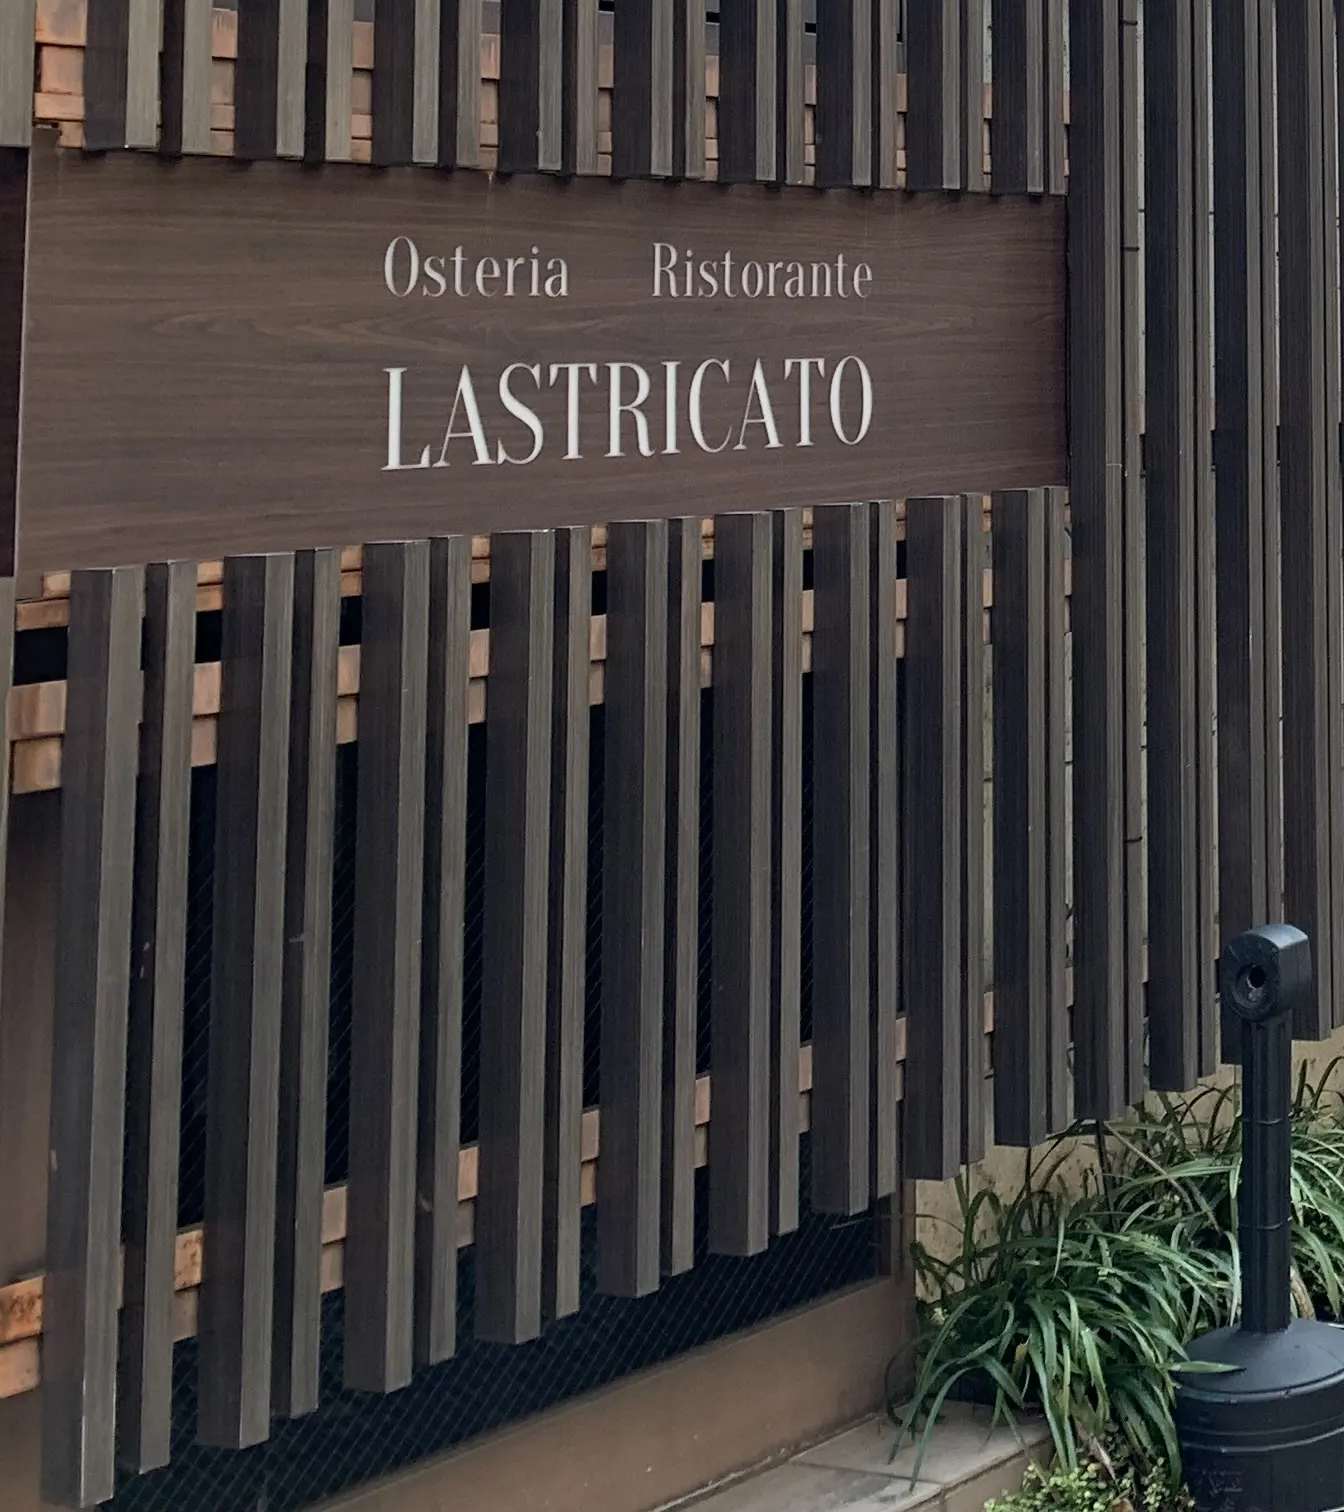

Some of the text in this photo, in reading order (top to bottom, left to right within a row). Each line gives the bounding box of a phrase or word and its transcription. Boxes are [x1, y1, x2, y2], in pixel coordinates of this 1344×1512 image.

[384, 234, 874, 299] Osteria Ristorante
[381, 354, 875, 472] LASTRICATO
